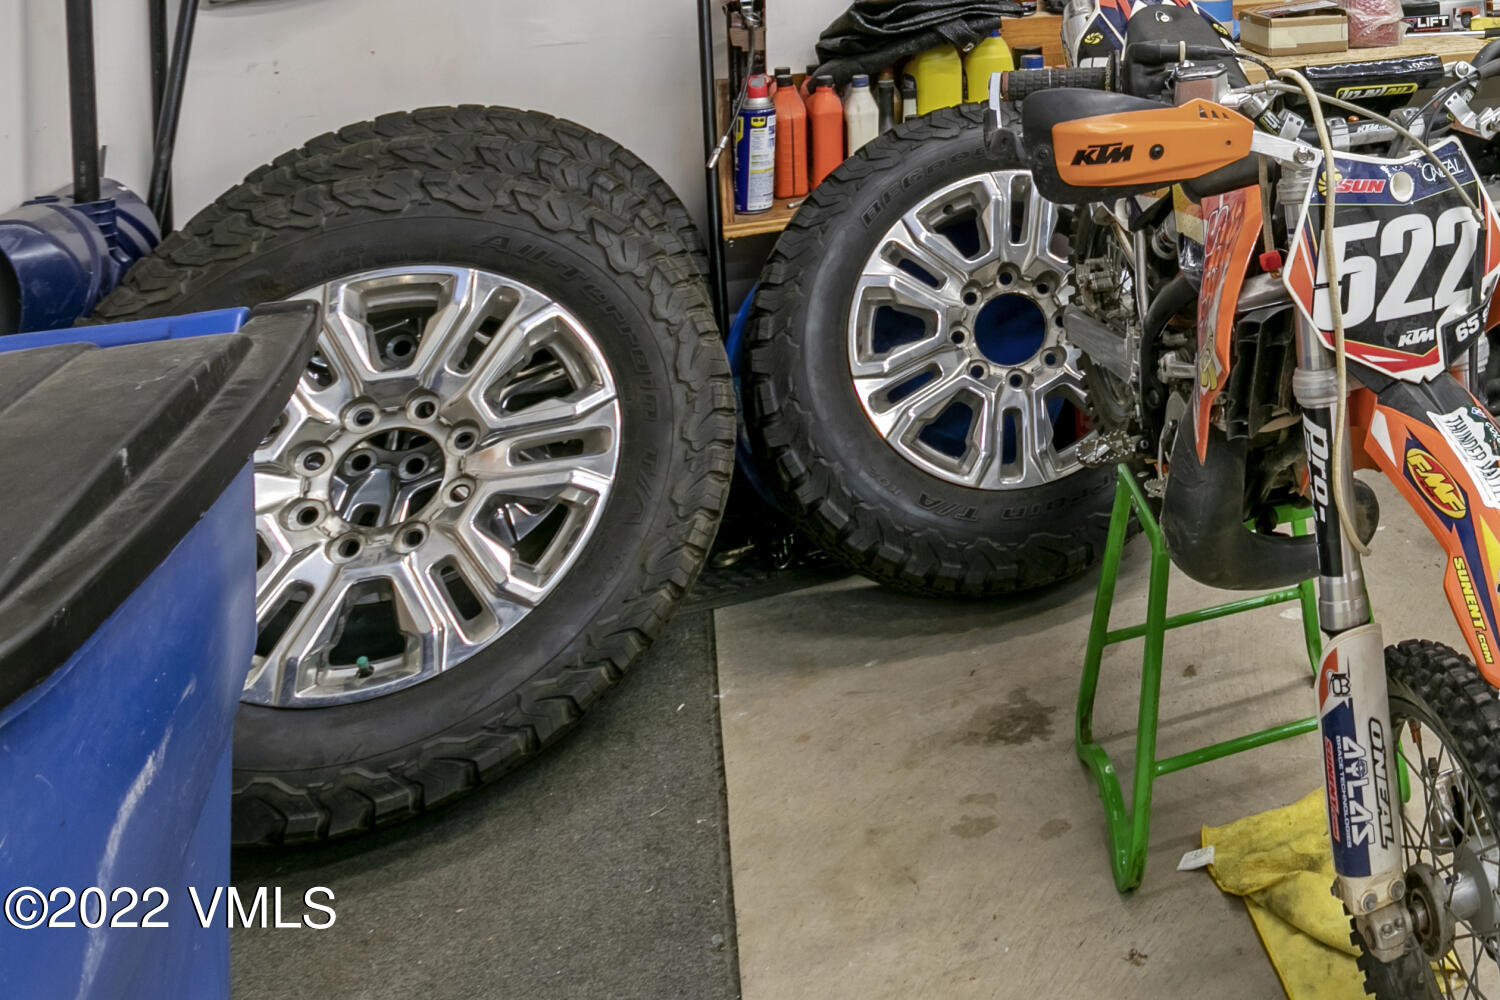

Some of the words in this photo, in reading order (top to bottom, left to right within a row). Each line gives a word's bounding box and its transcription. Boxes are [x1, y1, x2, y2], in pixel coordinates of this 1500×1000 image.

[1416, 15, 1449, 28] LIFT
[1071, 142, 1134, 166] KTM
[1335, 178, 1387, 194] SUN
[1312, 205, 1483, 332] 522
[1397, 326, 1435, 349] KTM
[1455, 312, 1480, 342] 65
[1446, 413, 1488, 462] THUNDER
[1406, 454, 1466, 512] FMF
[1335, 735, 1344, 769] BRACE
[1368, 717, 1394, 850] ONEAL
[1338, 771, 1352, 848] TECHNOLOGIES
